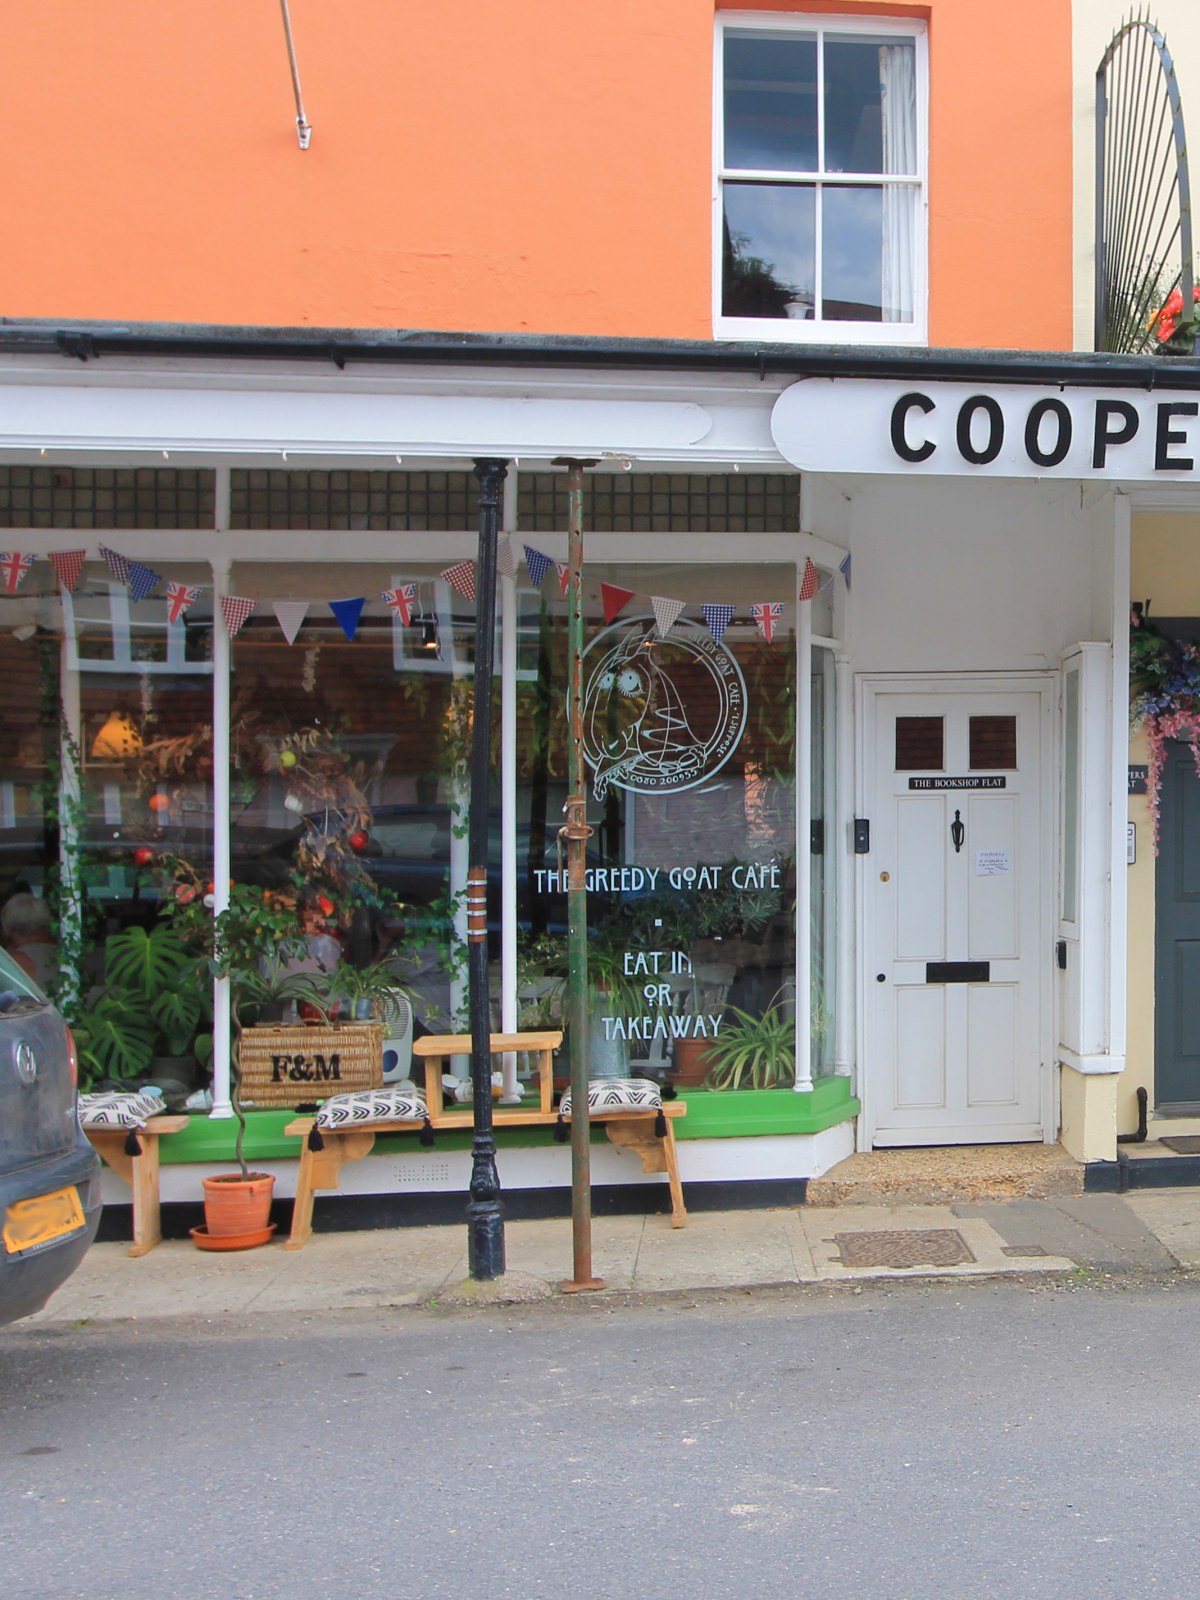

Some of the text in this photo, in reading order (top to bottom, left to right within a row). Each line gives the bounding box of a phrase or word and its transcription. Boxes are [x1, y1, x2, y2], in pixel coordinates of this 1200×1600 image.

[914, 778, 1003, 788] THE BOOKSHOP FLAT
[584, 867, 660, 892] GREEDY
[668, 865, 723, 890] GOAT
[624, 950, 695, 977] EAT IN
[643, 983, 672, 1007] OR
[601, 1014, 723, 1041] TAKEAWAY
[270, 1054, 342, 1083] F&M
